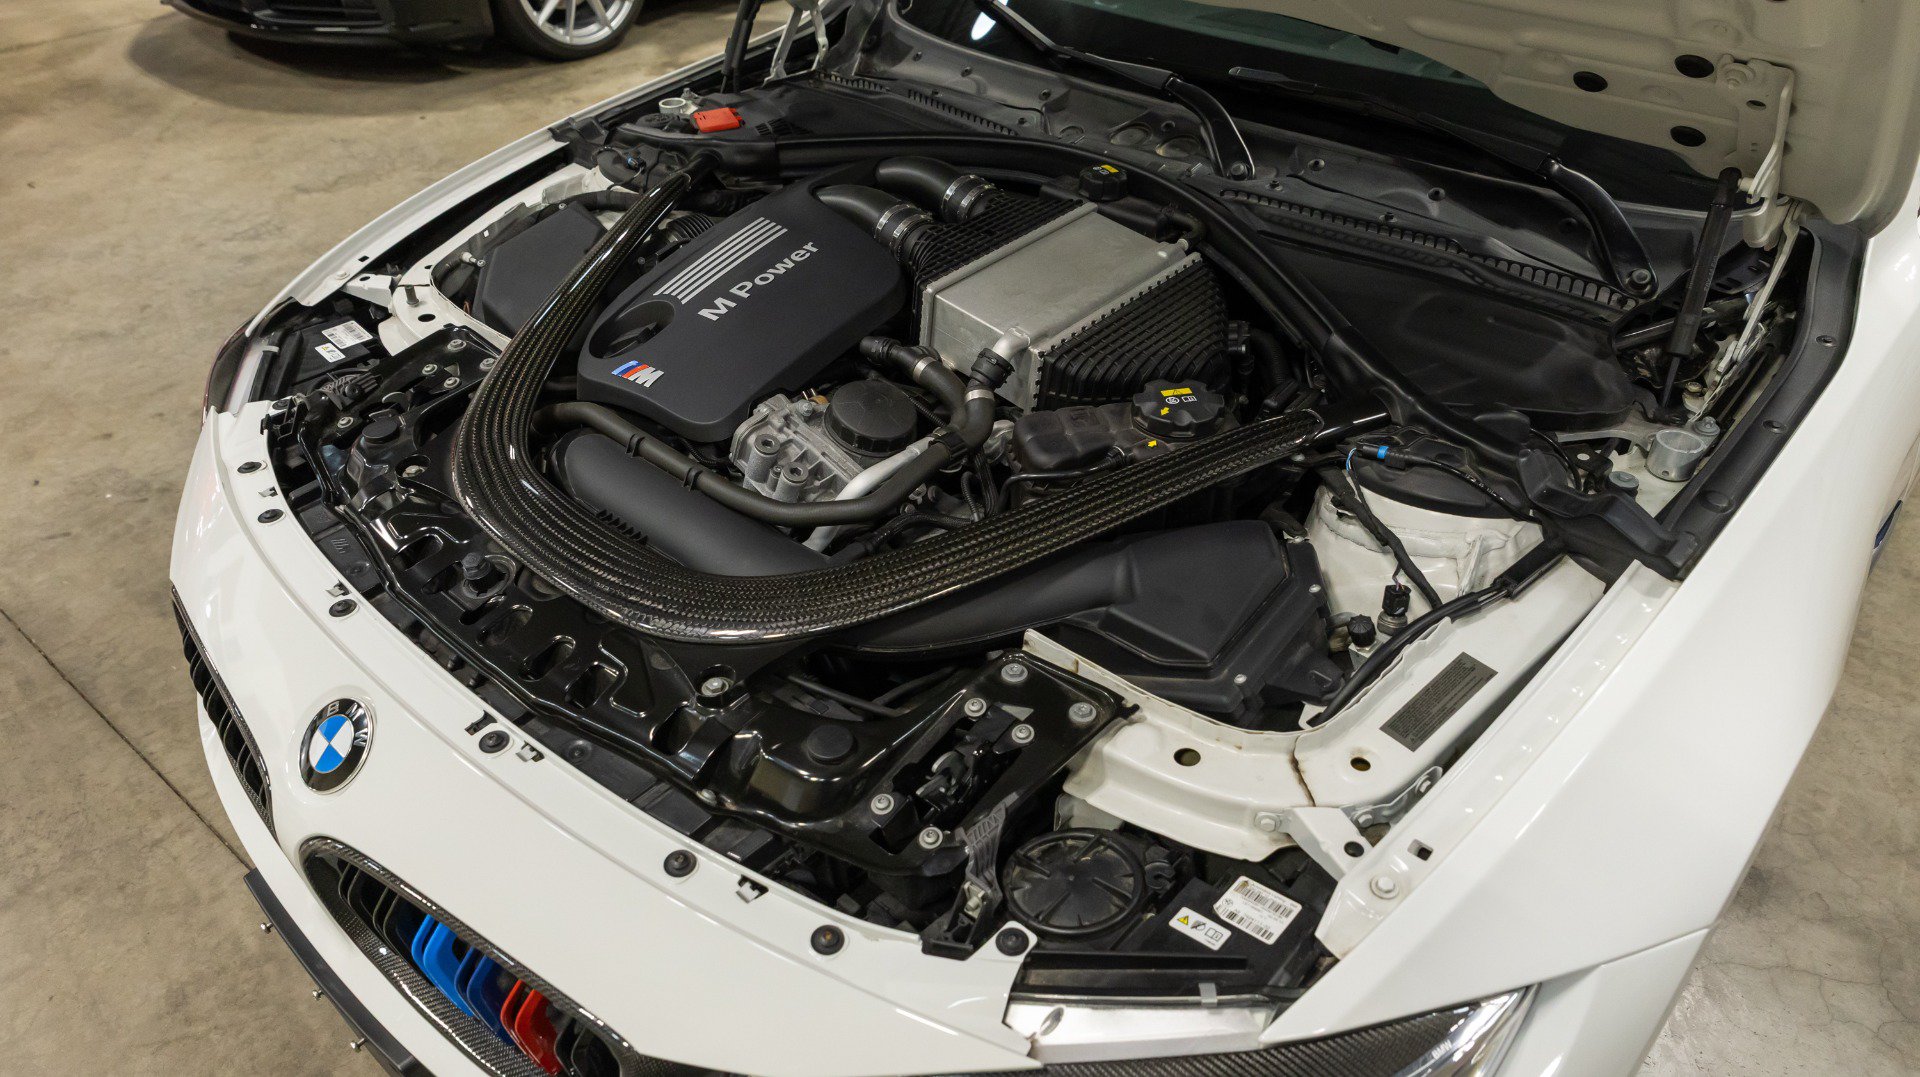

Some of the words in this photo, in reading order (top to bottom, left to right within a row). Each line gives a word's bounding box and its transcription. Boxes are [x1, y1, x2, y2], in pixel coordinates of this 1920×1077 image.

[698, 297, 738, 321] M
[729, 242, 819, 298] Power
[627, 366, 665, 388] M
[327, 701, 367, 747] BMW
[1431, 1039, 1452, 1060] BMW
